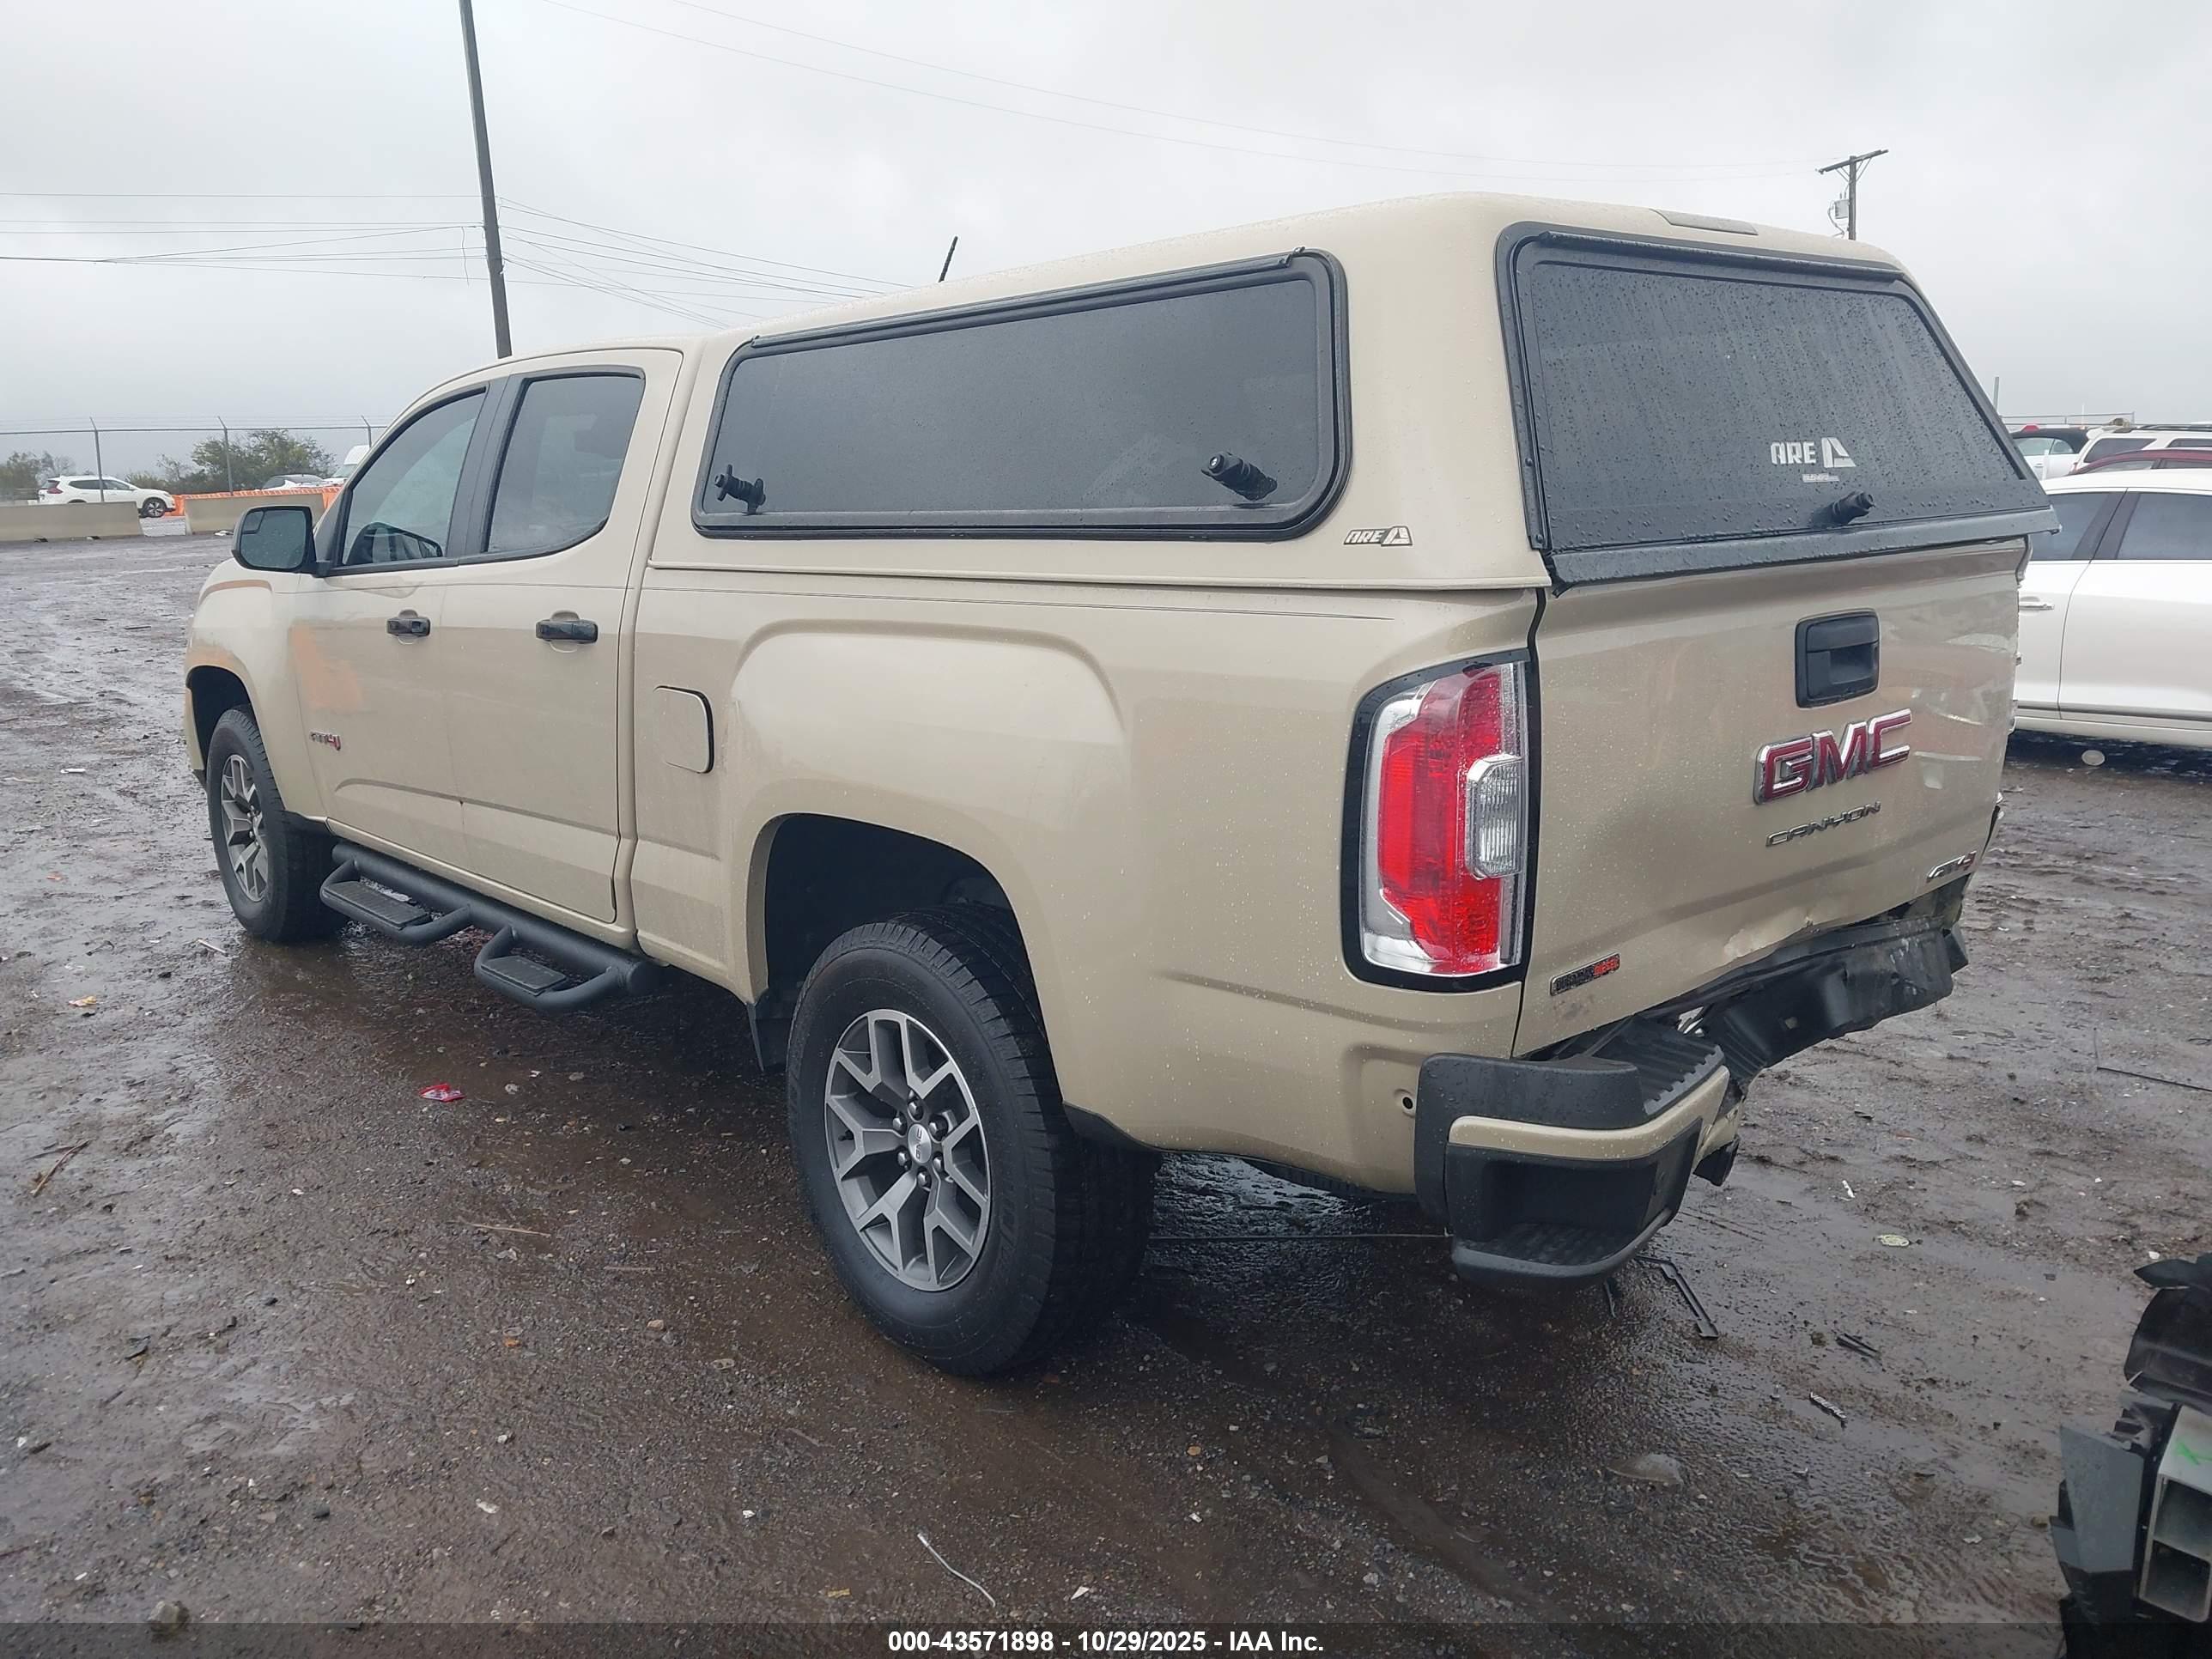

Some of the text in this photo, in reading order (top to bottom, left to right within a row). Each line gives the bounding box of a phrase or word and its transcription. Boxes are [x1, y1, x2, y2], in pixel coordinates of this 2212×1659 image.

[1770, 441, 1816, 465] ARE
[1753, 708, 1912, 805] GMC
[1765, 801, 1881, 847] CANYON
